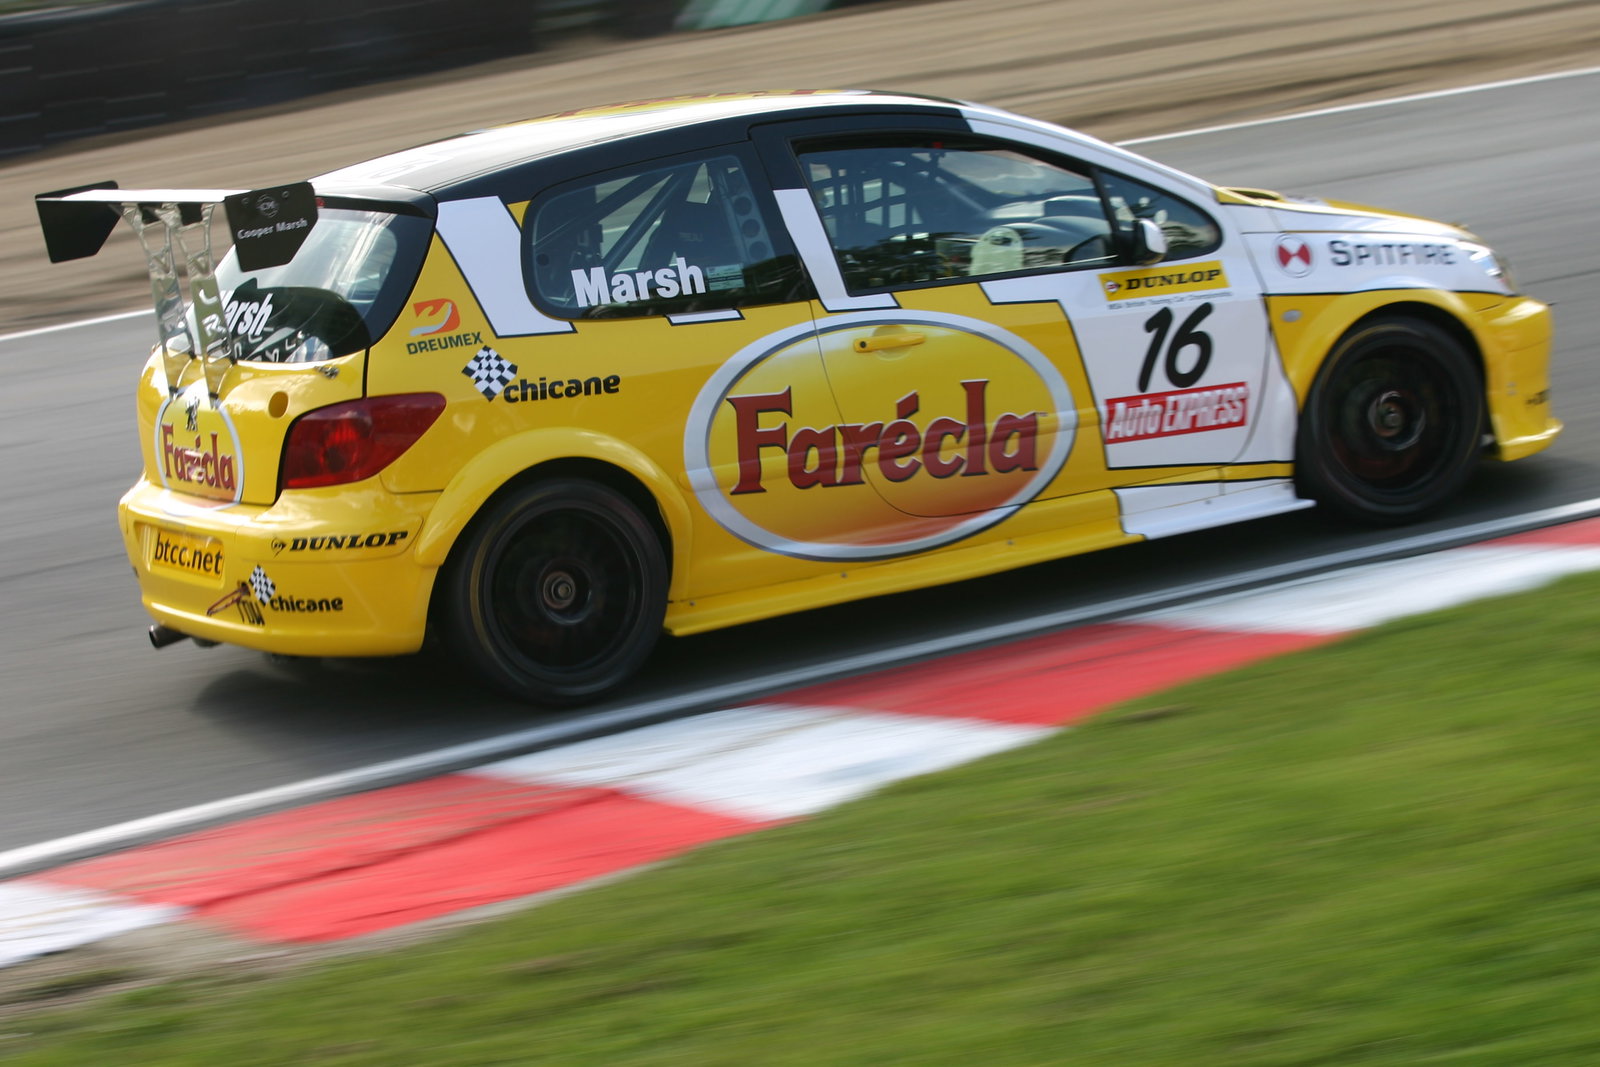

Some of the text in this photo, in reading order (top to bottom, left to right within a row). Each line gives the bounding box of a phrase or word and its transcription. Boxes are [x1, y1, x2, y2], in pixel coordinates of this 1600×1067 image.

[237, 217, 309, 240] Cooper Marsh
[1327, 239, 1458, 267] SPITFIRE
[571, 256, 707, 309] Marsh
[1124, 269, 1222, 291] DUNLOP
[406, 331, 484, 356] DREUMEX
[1137, 301, 1215, 393] 16
[503, 373, 621, 404] chicane
[1107, 399, 1164, 440] Auto
[726, 378, 1039, 496] Farécla
[153, 532, 223, 576] btcc.net
[289, 530, 409, 551] DUNLOP
[269, 595, 344, 612] chicane
